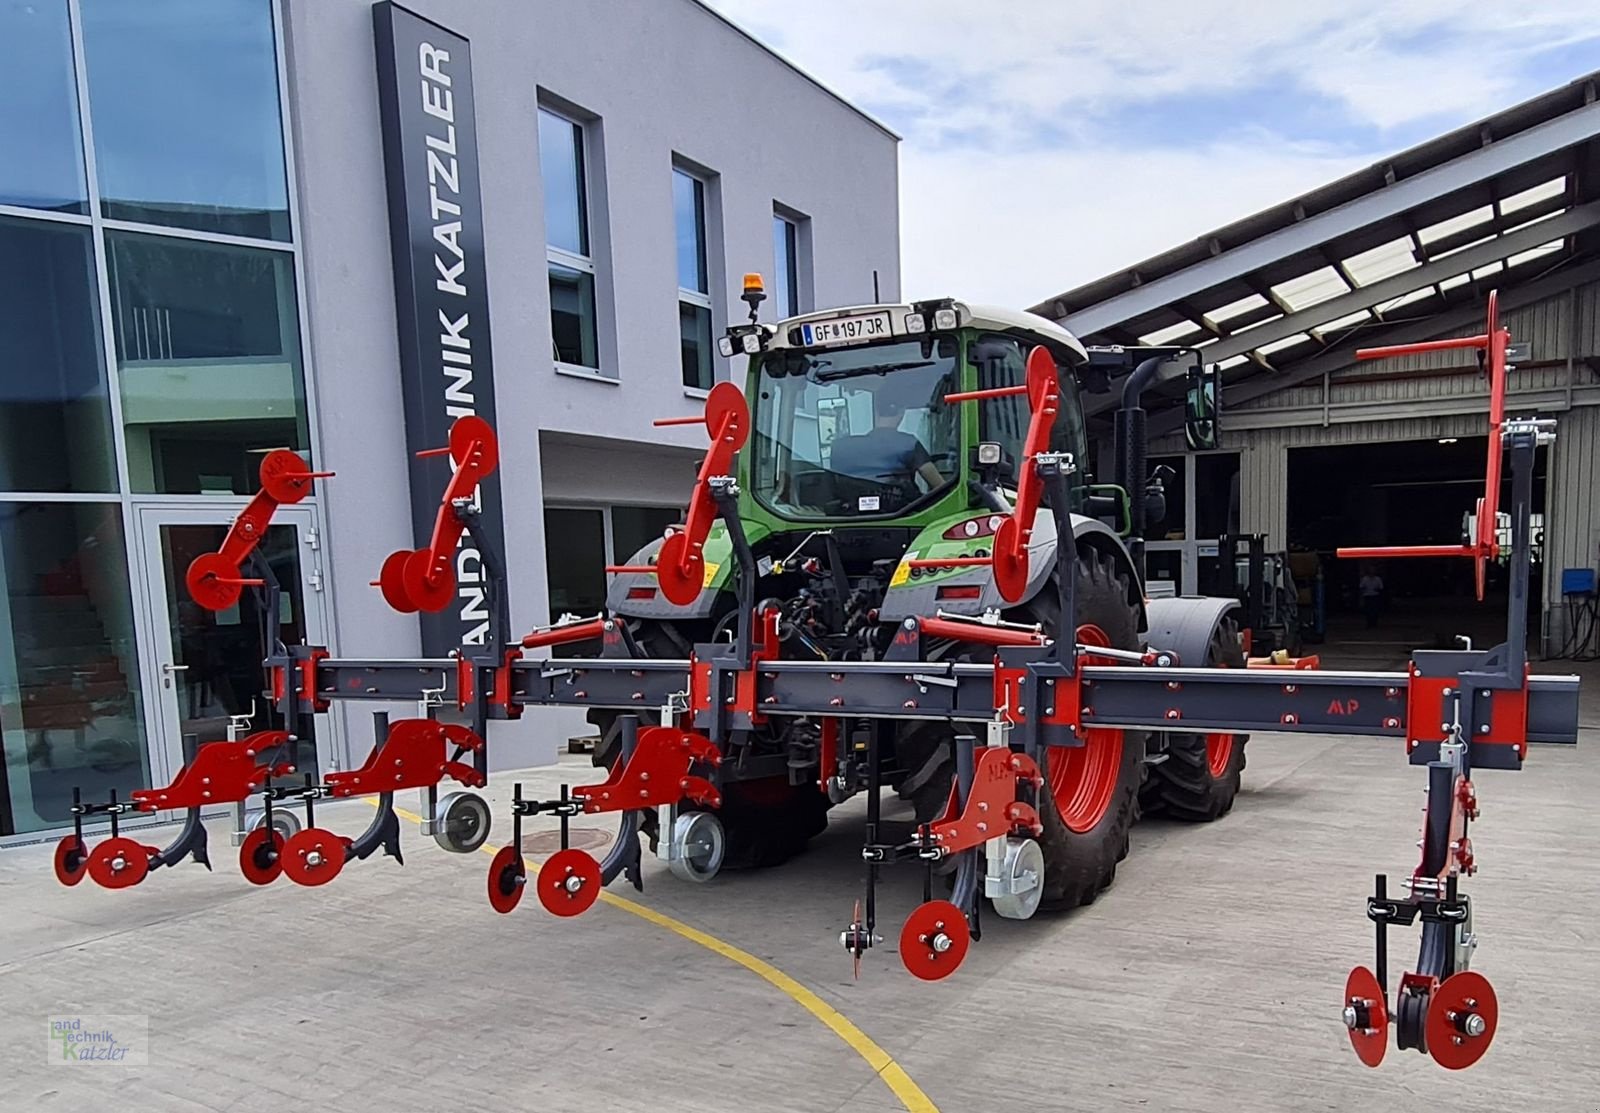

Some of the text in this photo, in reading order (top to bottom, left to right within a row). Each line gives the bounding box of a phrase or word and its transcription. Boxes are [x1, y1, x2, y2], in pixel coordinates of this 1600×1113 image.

[419, 41, 467, 296] KATZLER
[815, 318, 884, 341] GF 197 JR
